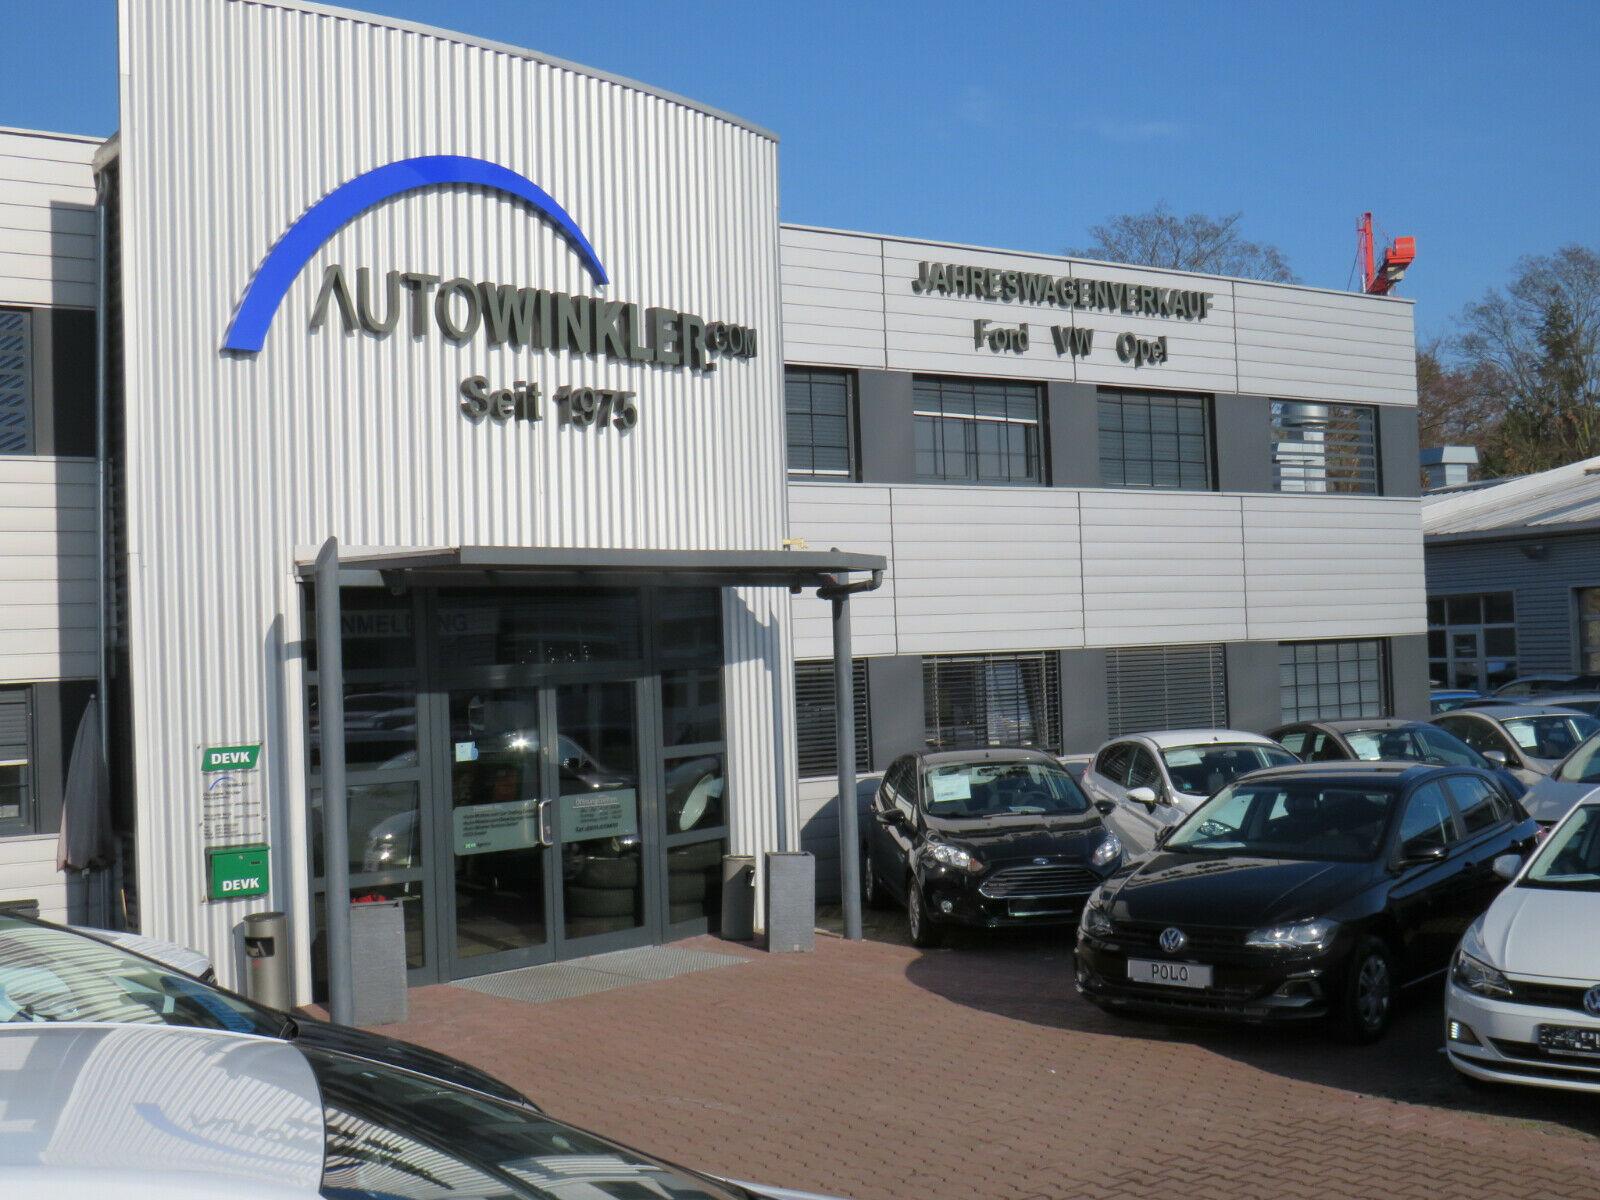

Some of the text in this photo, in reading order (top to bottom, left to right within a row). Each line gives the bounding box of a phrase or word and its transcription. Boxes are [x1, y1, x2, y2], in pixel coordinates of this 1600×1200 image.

[912, 261, 1214, 322] JAHRESWAGENVERKAUF
[973, 319, 1168, 368] Ford VW Opel
[460, 375, 638, 432] Seit 1975
[211, 751, 251, 765] DEVK
[222, 877, 260, 892] DEVK
[1151, 963, 1189, 981] POLO
